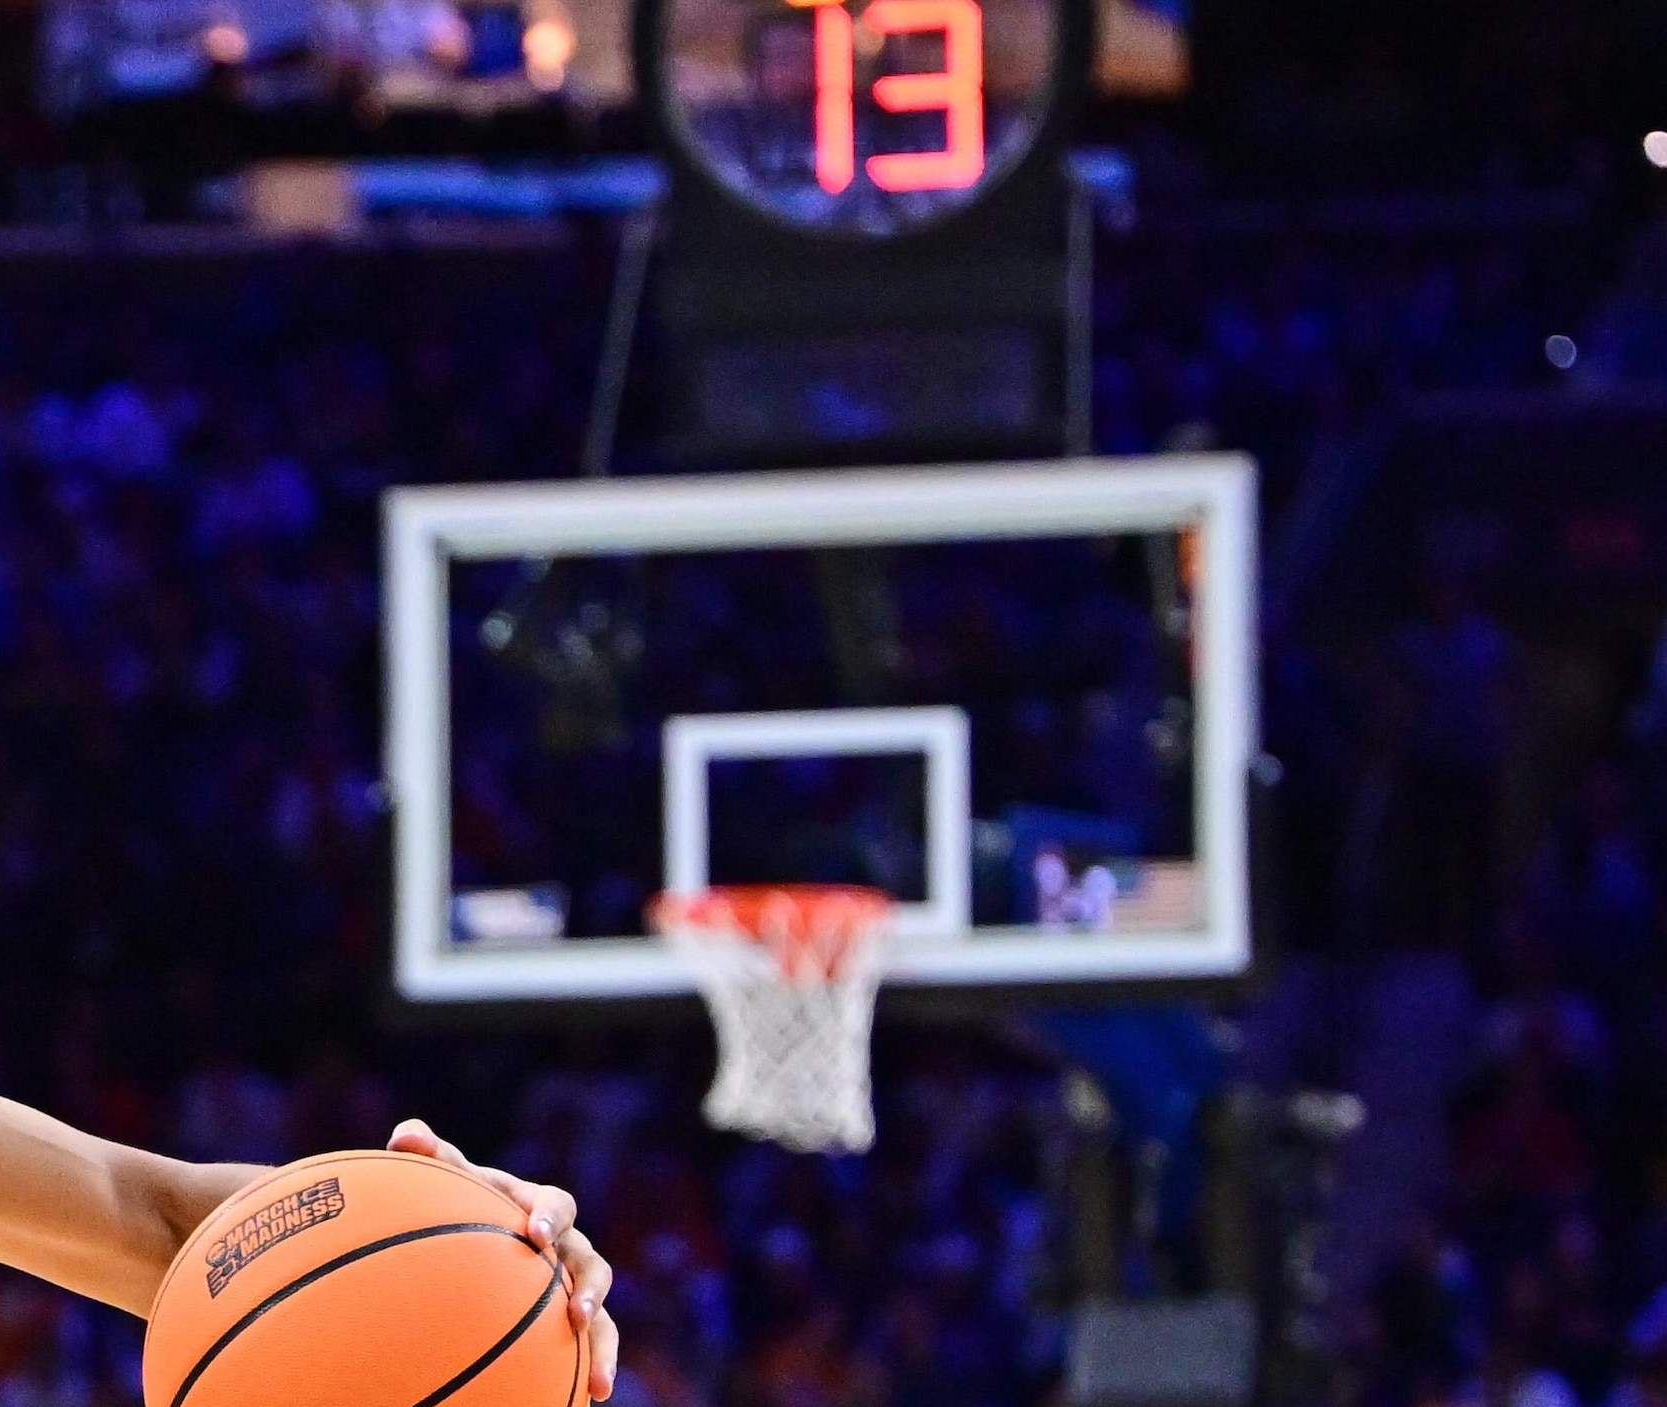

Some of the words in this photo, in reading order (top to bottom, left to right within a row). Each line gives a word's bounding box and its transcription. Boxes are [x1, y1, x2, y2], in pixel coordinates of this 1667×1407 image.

[814, 0, 985, 194] 13
[225, 1193, 300, 1249] MARCH
[240, 1193, 345, 1259] MADNESS
